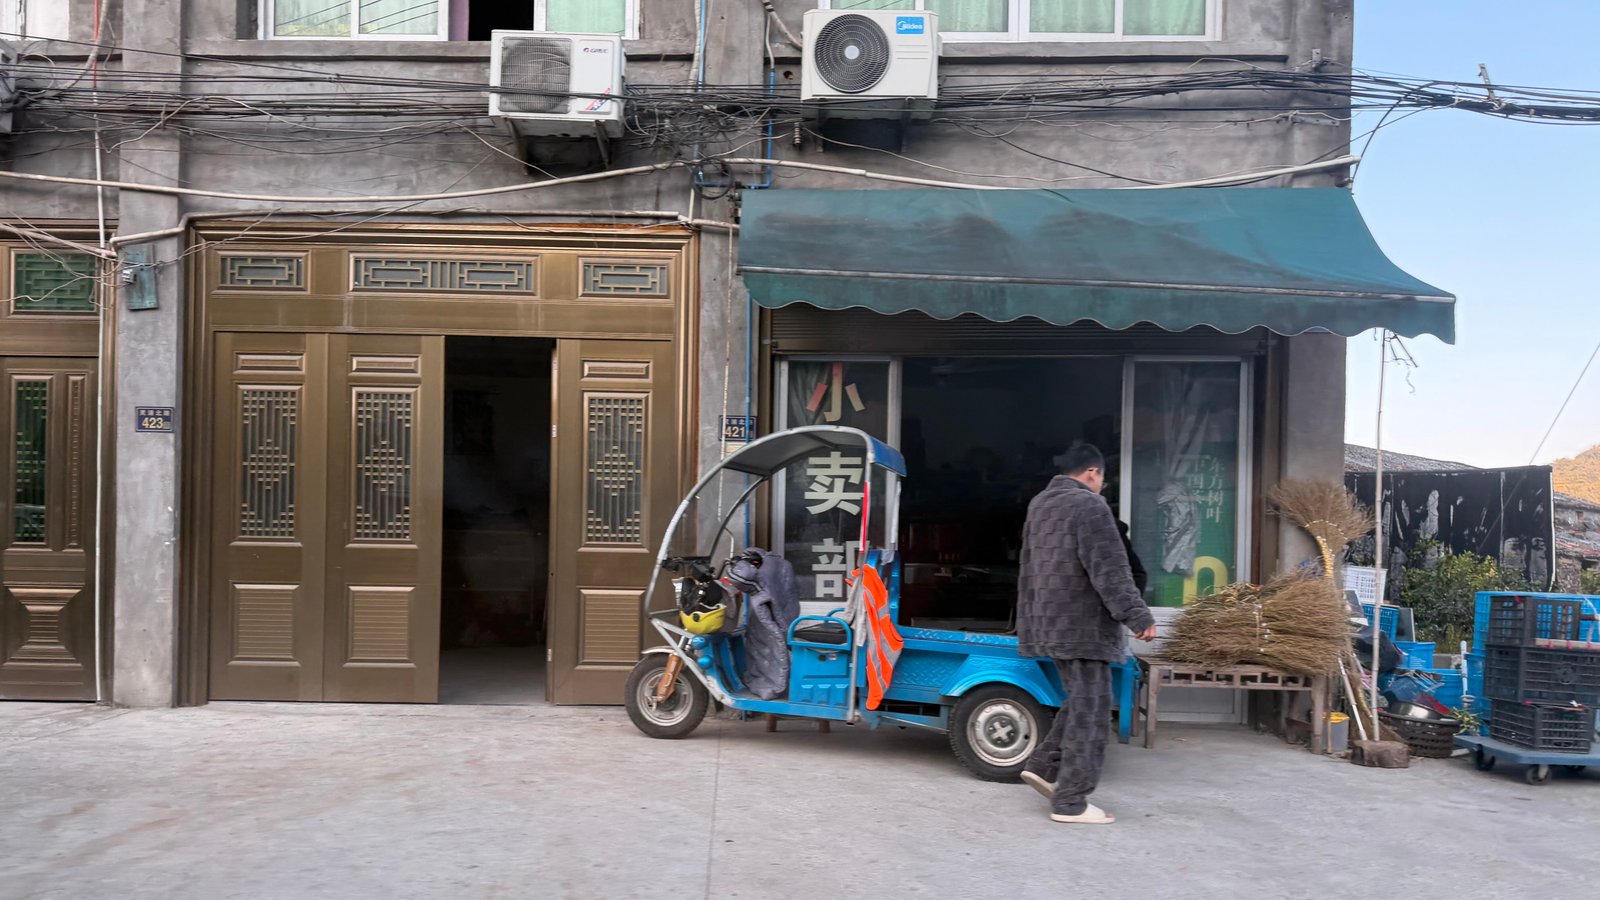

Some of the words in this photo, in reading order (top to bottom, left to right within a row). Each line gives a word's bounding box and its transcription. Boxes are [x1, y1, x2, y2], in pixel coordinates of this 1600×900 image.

[142, 417, 164, 429] 423
[725, 426, 745, 437] 421
[804, 362, 870, 598] 小卖部
